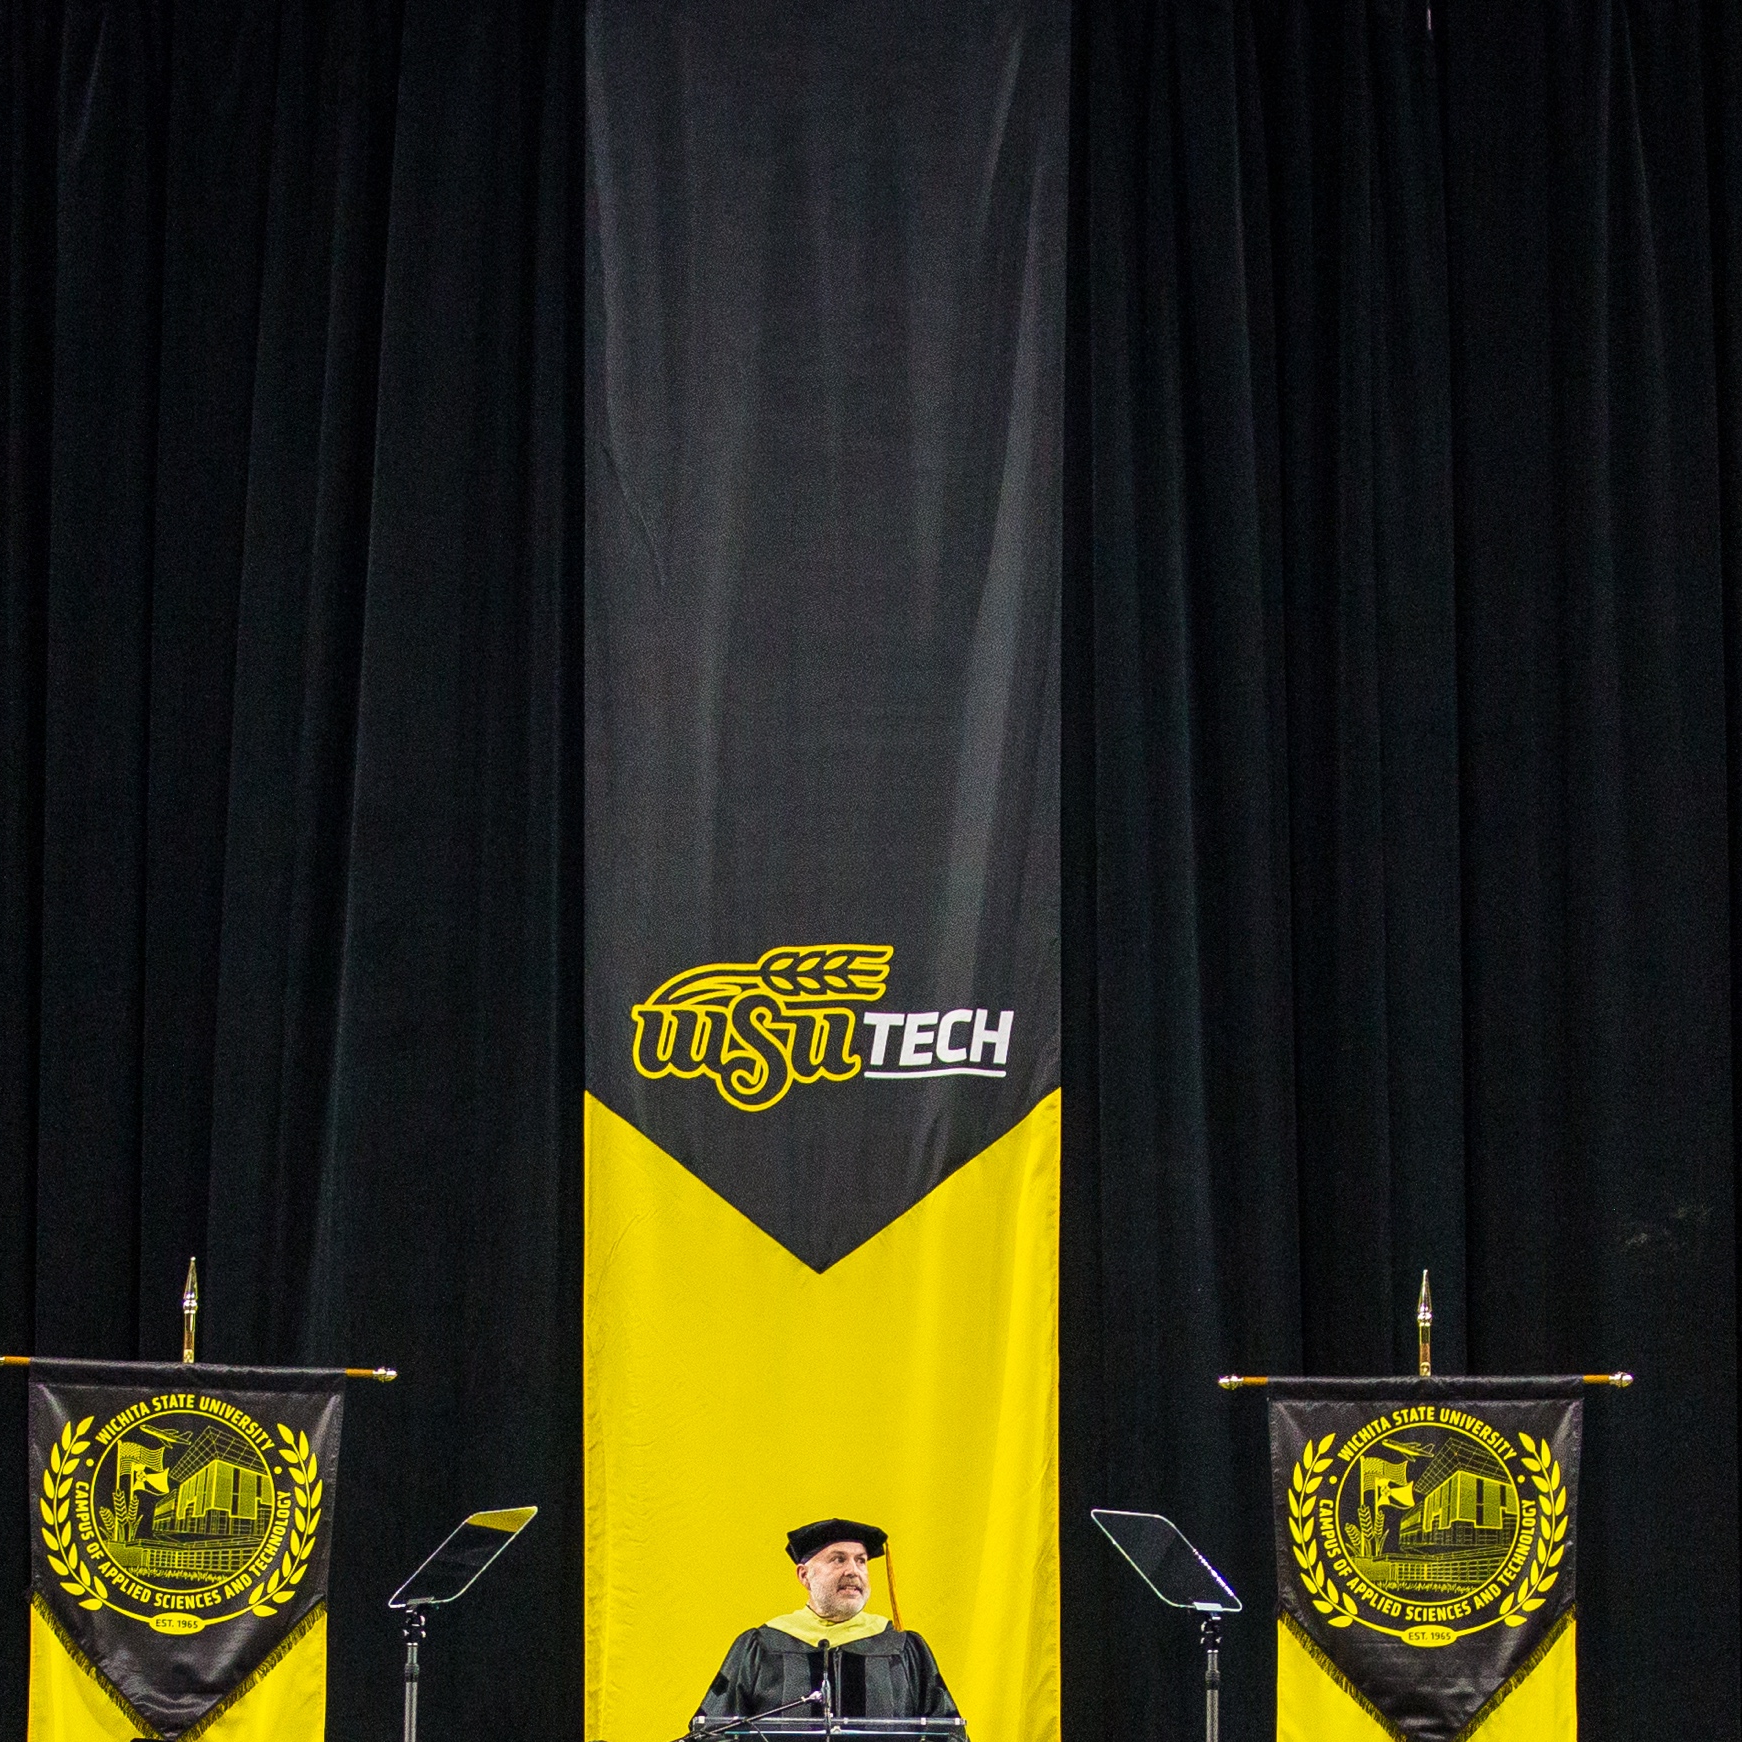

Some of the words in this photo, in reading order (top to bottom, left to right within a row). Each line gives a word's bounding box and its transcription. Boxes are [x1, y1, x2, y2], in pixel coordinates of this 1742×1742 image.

[863, 1007, 1015, 1067] TECH
[95, 1401, 151, 1445] WICHITA
[151, 1393, 195, 1411] STATE
[199, 1396, 275, 1451] UNIVERSITY
[1337, 1416, 1392, 1461] WICHITA
[1392, 1406, 1435, 1426] STATE
[1439, 1408, 1517, 1460] UNIVERSITY
[75, 1481, 95, 1541] CAMPUS
[86, 1543, 105, 1560] OF
[98, 1561, 151, 1603] APPLIED
[154, 1589, 222, 1610] SCIENCES
[224, 1573, 253, 1599] AND
[248, 1491, 291, 1577] TECHNOLOGY
[1319, 1499, 1342, 1558] CAMPUS
[1333, 1559, 1353, 1577] OF
[1346, 1577, 1402, 1617] APPLIED
[1405, 1600, 1472, 1622] SCIENCES
[1473, 1583, 1502, 1610] AND
[1497, 1499, 1537, 1587] TECHNOLOGY
[155, 1619, 174, 1628] EST.
[177, 1620, 199, 1629] 1965
[1408, 1632, 1428, 1641] EST.
[1430, 1631, 1451, 1641] 1965
